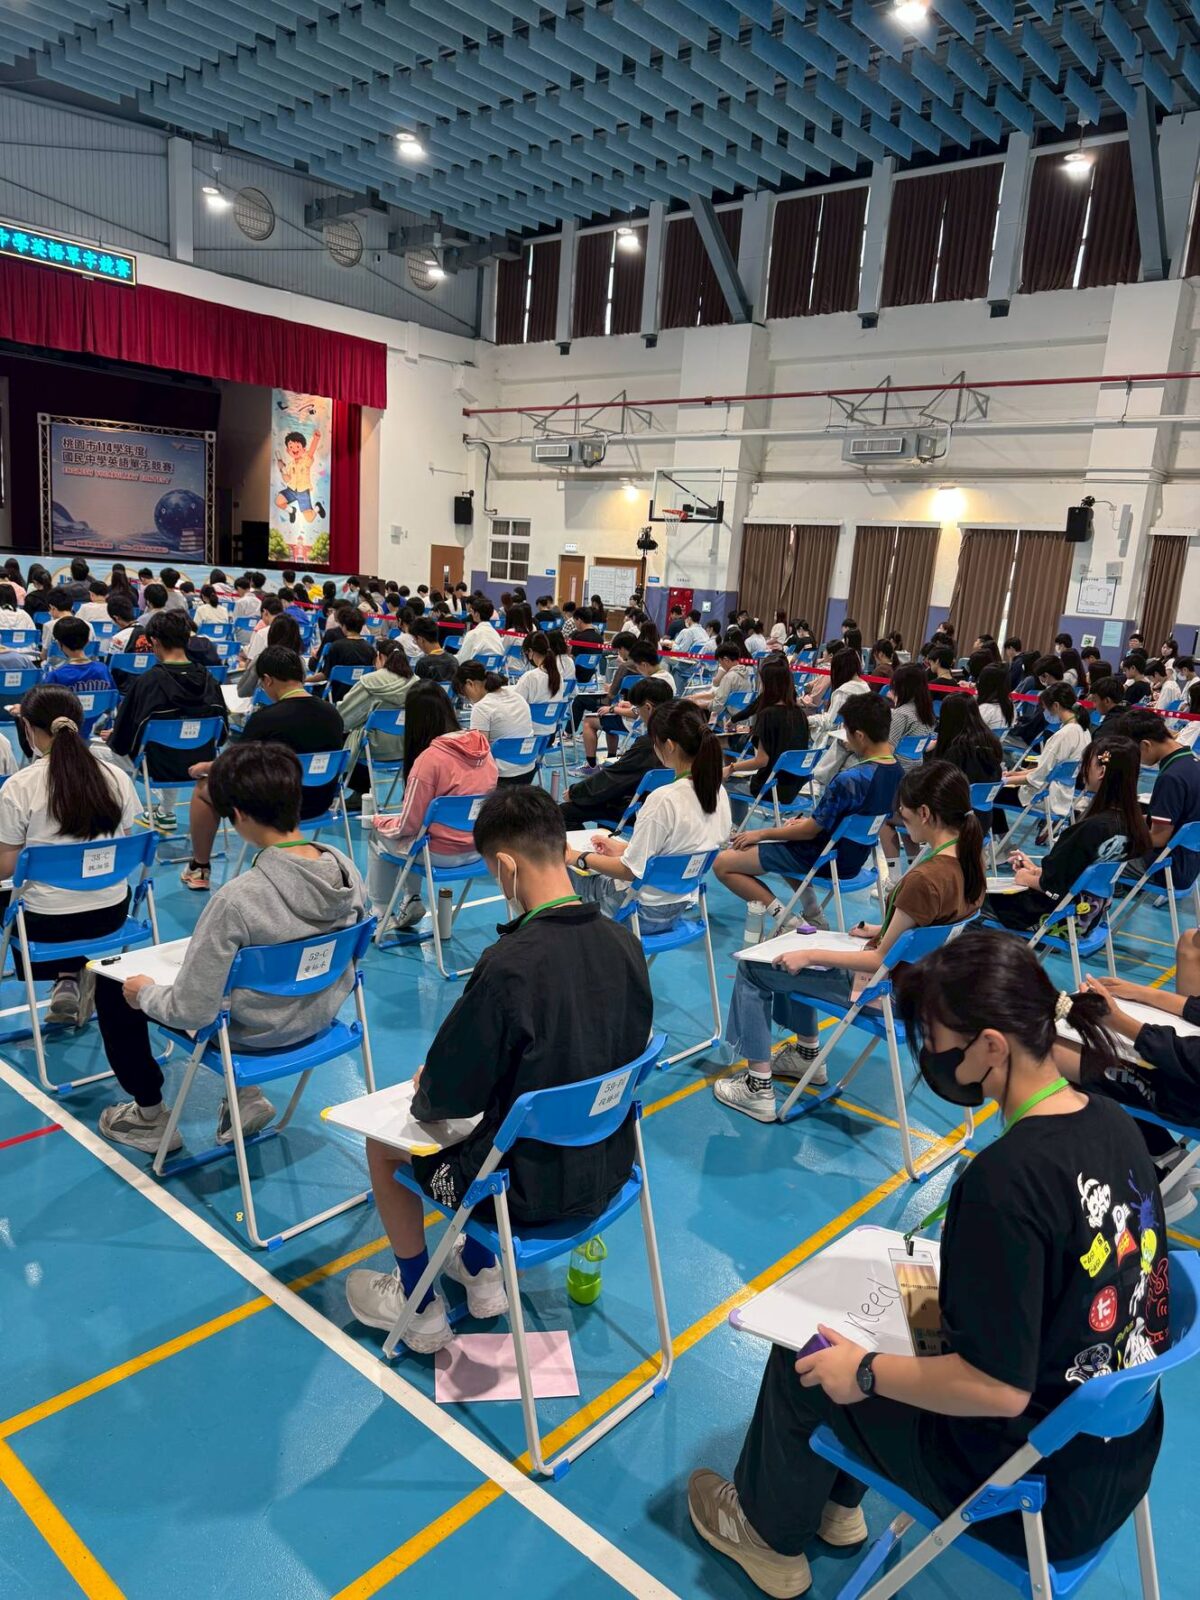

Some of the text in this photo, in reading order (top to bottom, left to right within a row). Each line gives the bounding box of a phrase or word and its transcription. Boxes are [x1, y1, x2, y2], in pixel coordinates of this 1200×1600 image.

[63, 438, 146, 457] 桃園市114學年度
[63, 452, 173, 473] 國民中學英語單字競賽
